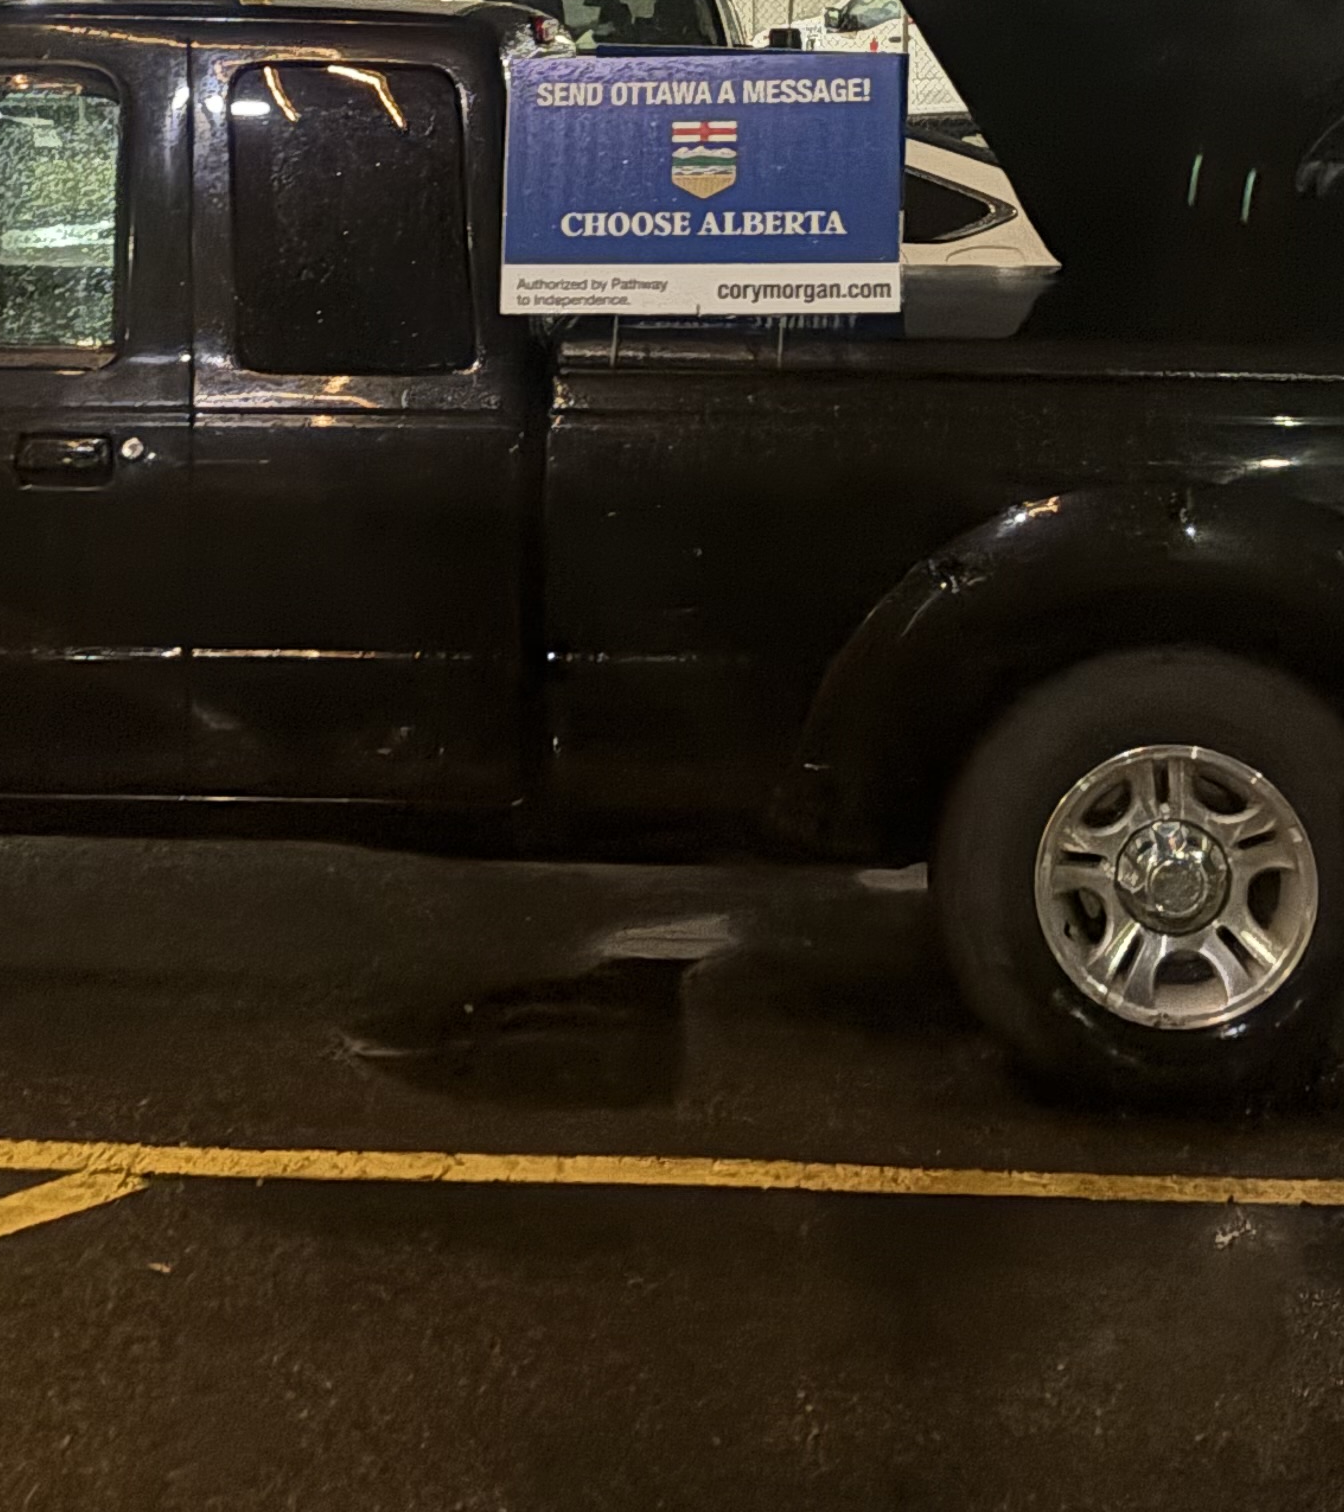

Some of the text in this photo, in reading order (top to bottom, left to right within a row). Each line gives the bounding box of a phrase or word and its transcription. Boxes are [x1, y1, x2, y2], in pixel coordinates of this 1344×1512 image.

[536, 78, 871, 106] SEND OTTAWA A MESSAGE!
[560, 210, 847, 237] CHOOSE ALBERTA
[516, 278, 589, 291] Authorized
[591, 279, 608, 292] by
[716, 279, 892, 303] corymorgan.com
[516, 294, 632, 308] to Independence.
